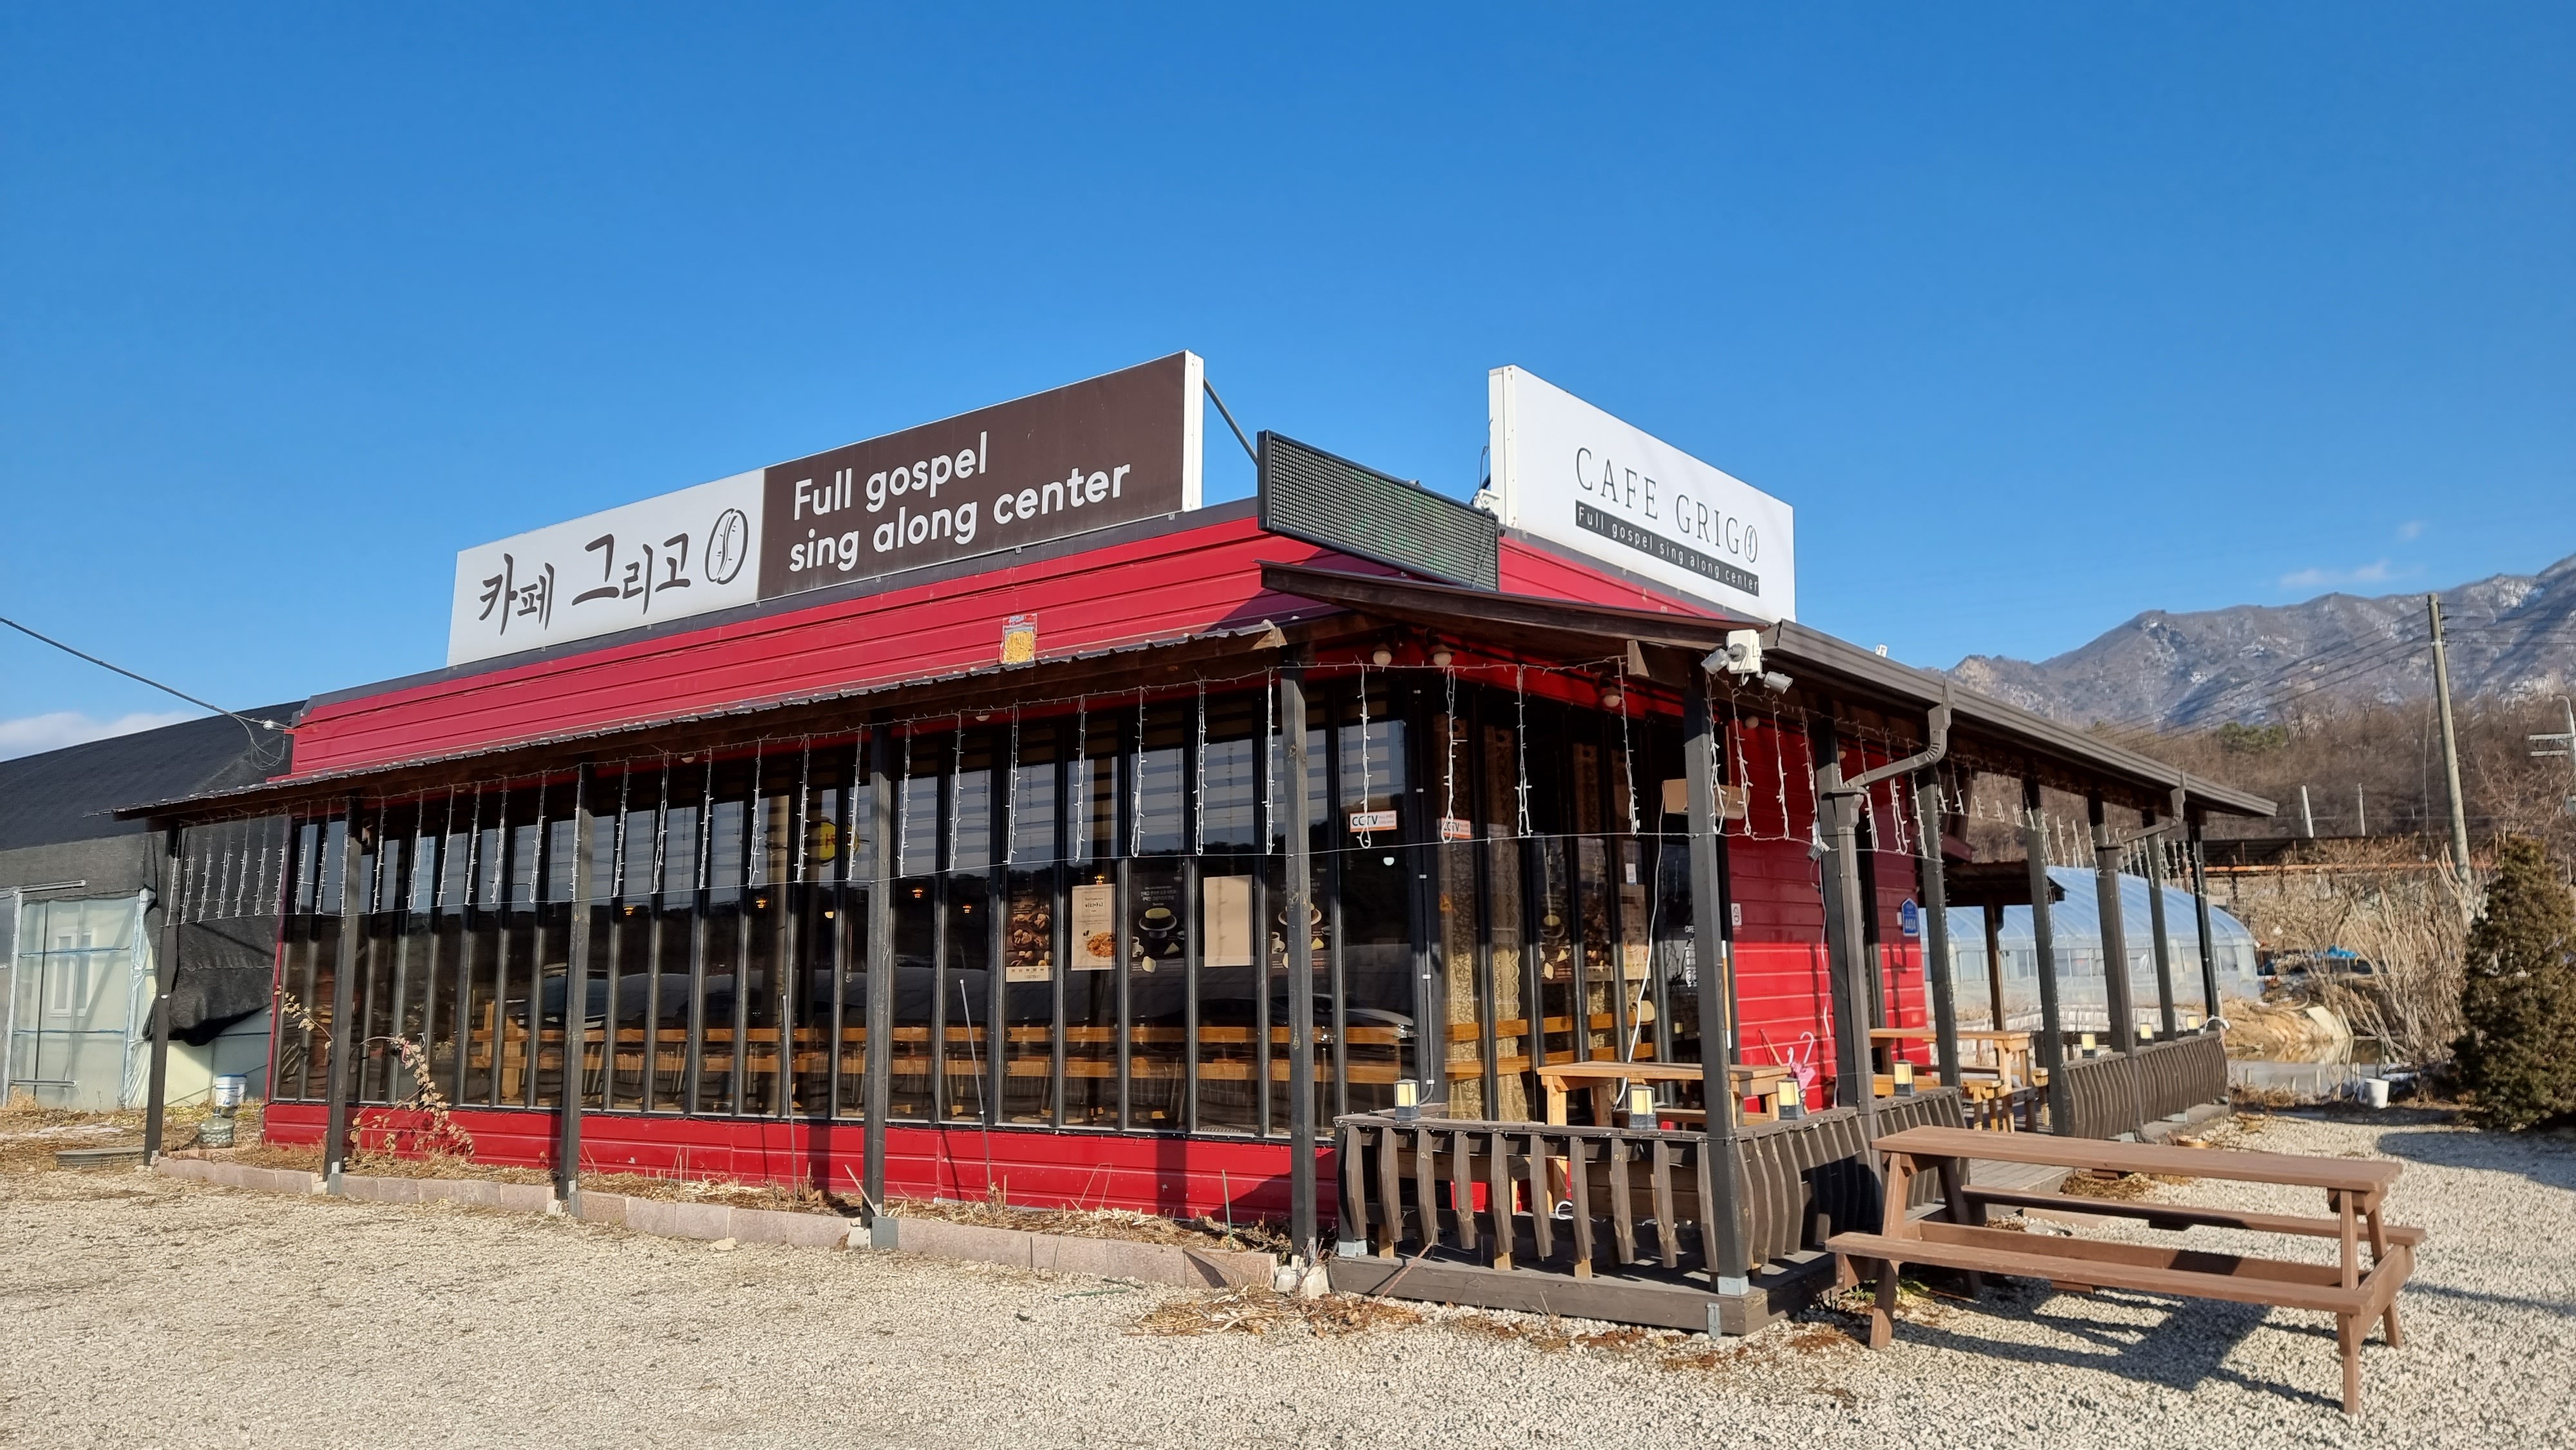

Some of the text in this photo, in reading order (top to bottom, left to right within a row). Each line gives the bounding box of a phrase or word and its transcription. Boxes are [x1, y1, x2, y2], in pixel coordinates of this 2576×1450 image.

[788, 463, 1131, 572] sing along center
[793, 430, 988, 521] Full gospel
[1576, 447, 1658, 520] CAFE
[478, 532, 691, 636] 카페 그리고
[1578, 505, 1759, 592] Full gospel sing along center
[1352, 814, 1378, 827] CCTV
